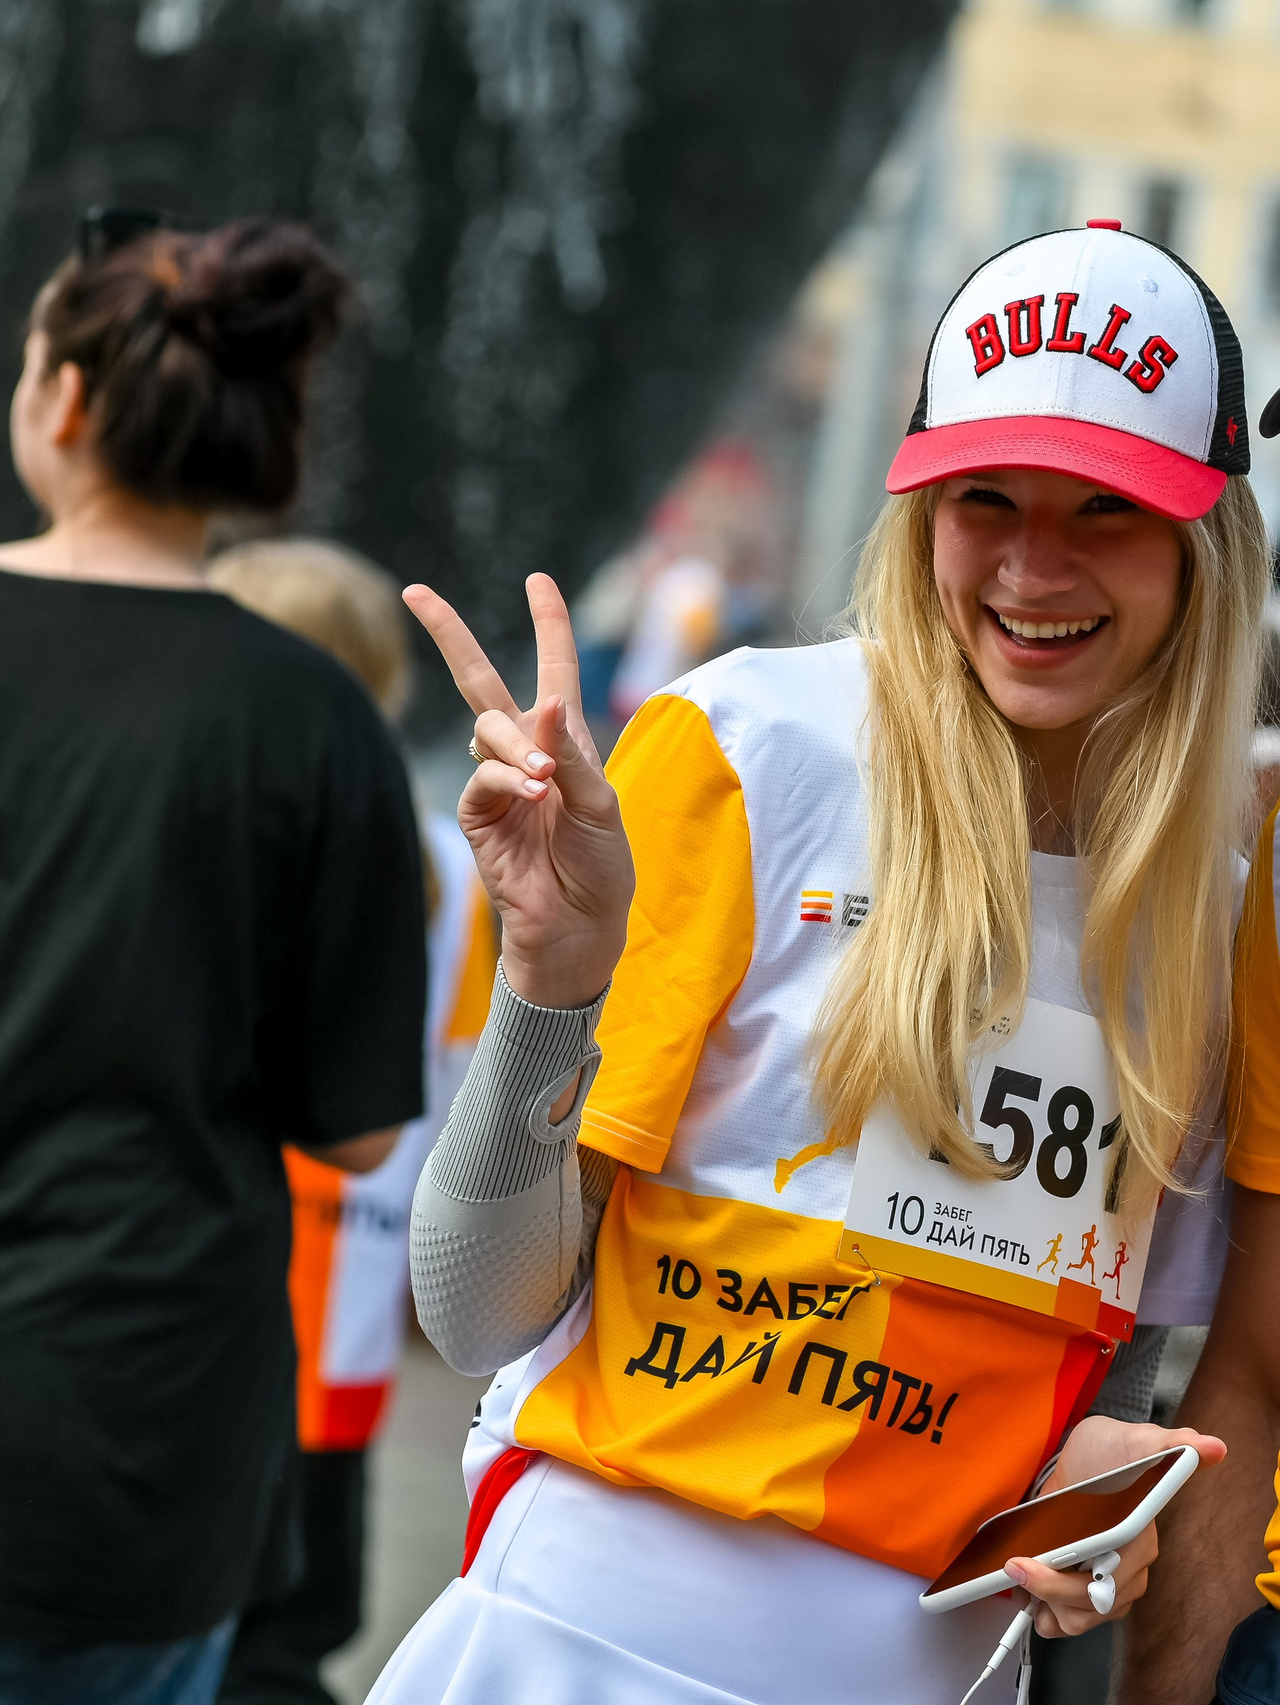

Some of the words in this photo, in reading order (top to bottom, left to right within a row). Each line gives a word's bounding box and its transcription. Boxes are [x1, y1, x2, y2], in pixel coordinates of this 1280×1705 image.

[965, 291, 1179, 393] BULLS
[886, 1192, 925, 1236] 10
[933, 1202, 972, 1222] ЗАБЕГ
[926, 1220, 975, 1250] ДАЙ
[980, 1234, 1031, 1265] ПЯТЬ
[656, 1254, 702, 1300] 10
[716, 1268, 870, 1321] ЗАБЕГ
[623, 1321, 782, 1389] ДАЙ
[787, 1341, 959, 1445] ПЯТЬ!
